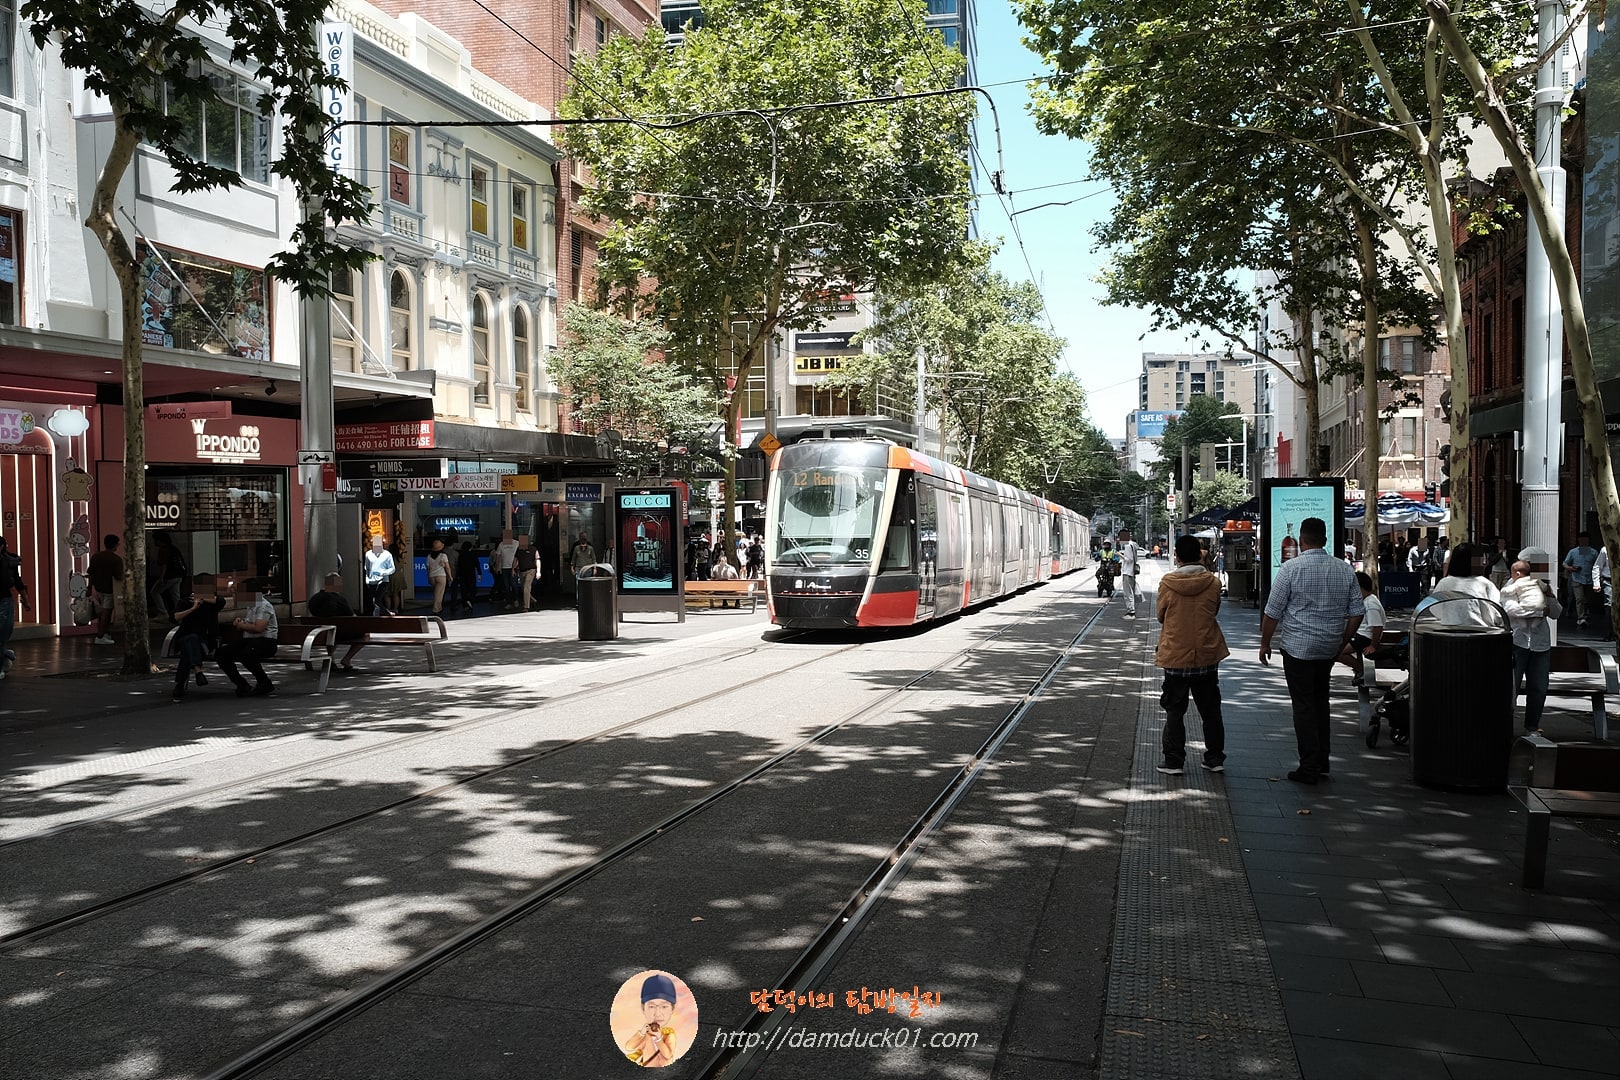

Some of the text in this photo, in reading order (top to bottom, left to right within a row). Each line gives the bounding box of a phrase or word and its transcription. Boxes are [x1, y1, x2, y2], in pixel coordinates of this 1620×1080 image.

[797, 358, 821, 370] JB
[157, 412, 186, 420] IPPONDO
[1140, 414, 1155, 422] SAFE
[0, 427, 20, 440] DS
[196, 434, 261, 453] IPPONDO
[336, 436, 431, 450] 0416 490 160 FOR LEASE
[377, 461, 403, 473] MOMOS
[400, 478, 447, 489] SYDNEY
[453, 481, 495, 489] KARAOKE
[623, 497, 669, 506] GUCCI
[146, 504, 180, 519] NDO
[435, 517, 473, 525] CURRENCY
[855, 548, 869, 559] 35
[1384, 585, 1409, 593] PERONI
